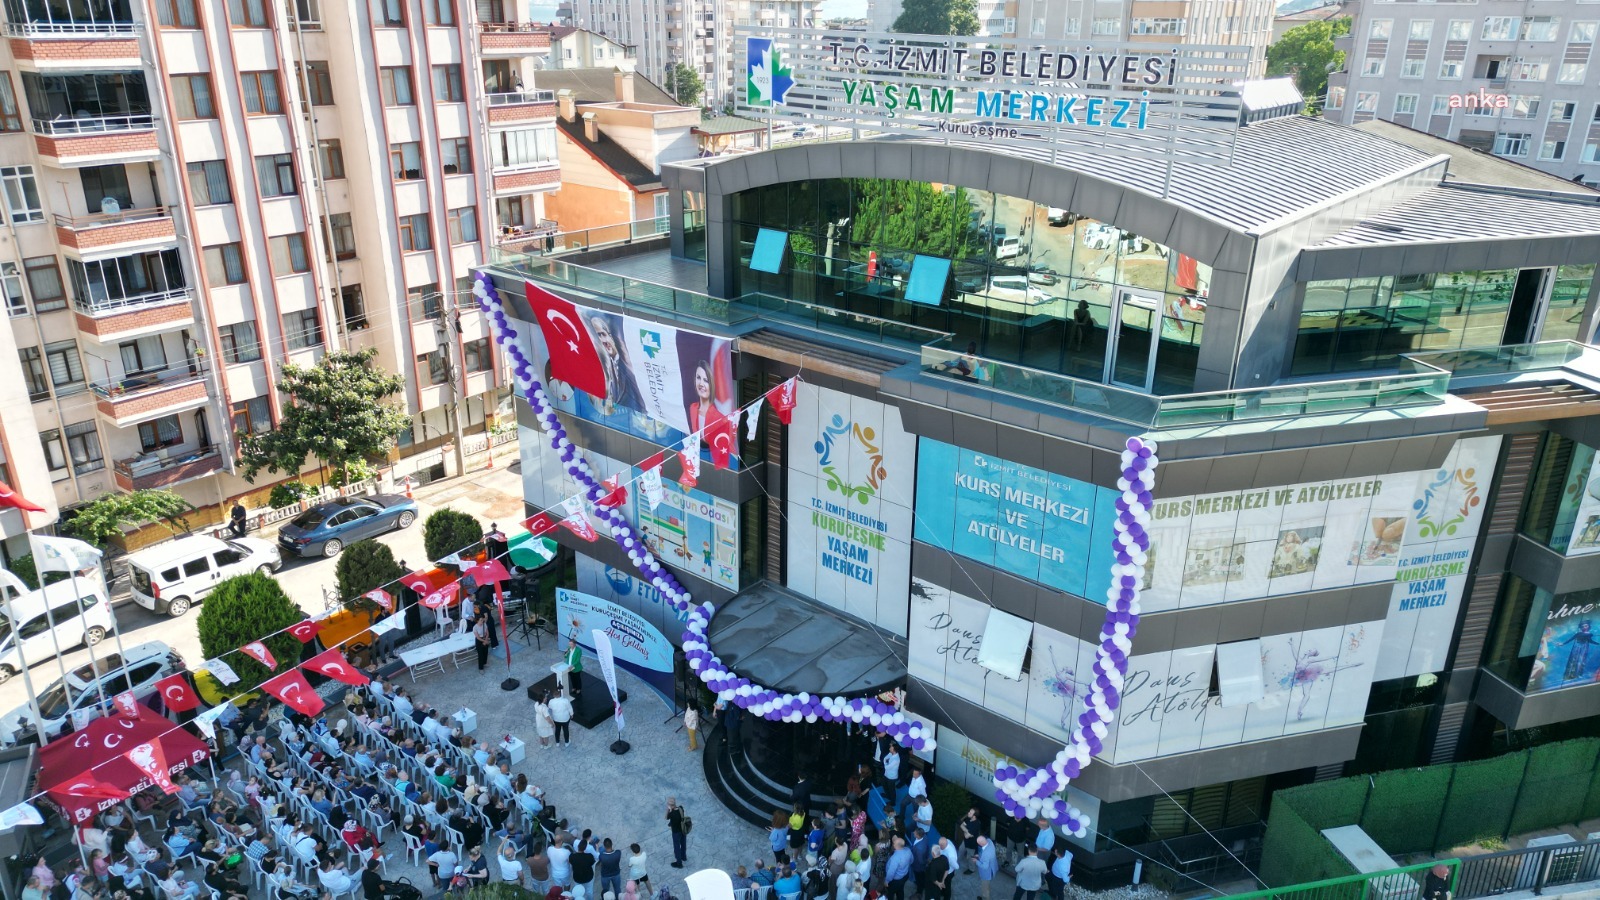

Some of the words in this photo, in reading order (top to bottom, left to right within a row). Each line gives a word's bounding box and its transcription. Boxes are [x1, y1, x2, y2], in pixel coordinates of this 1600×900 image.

[888, 38, 967, 74] İZMİT
[980, 45, 1178, 86] BELEDİYESİ
[842, 80, 955, 118] YAŞAM
[976, 91, 1150, 130] MERKEZİ
[938, 120, 1018, 140] Kuruçeşme
[954, 471, 1001, 499] KURS
[1004, 486, 1090, 526] MERKEZİ
[1194, 487, 1270, 516] MERKEZİ
[1274, 488, 1293, 506] VE
[1296, 479, 1383, 504] ATÖLYELER
[825, 500, 847, 518] İZMİT
[846, 510, 888, 533] BELEDİYESİ
[1005, 508, 1030, 530] VE
[827, 535, 869, 565] YAŞAM
[967, 519, 1066, 564] ATÖLYELER
[1431, 548, 1470, 563] BELEDİYESİ
[821, 551, 874, 586] MERKEZİ
[1398, 591, 1448, 612] MERKEZİ
[1408, 578, 1447, 596] YAŞAM
